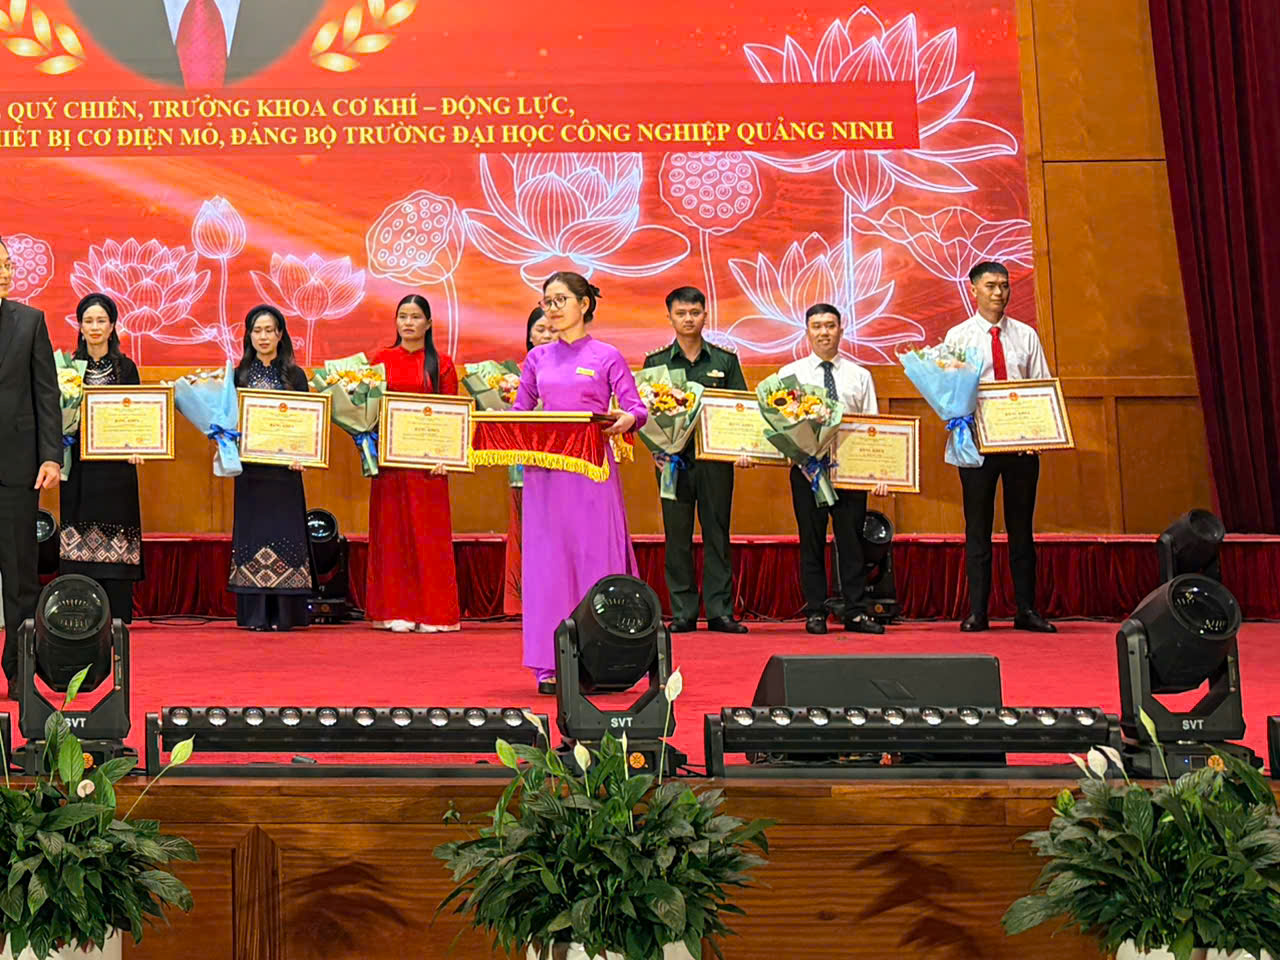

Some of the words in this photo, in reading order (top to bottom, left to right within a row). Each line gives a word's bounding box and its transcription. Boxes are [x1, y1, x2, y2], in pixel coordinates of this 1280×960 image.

[7, 96, 57, 123] QUÝ
[63, 96, 144, 121] CHIẾN,
[148, 94, 250, 118] TRƯỞNG
[257, 99, 327, 117] KHOA
[332, 97, 368, 117] CƠ
[373, 93, 418, 116] KHÍ
[441, 96, 511, 119] ĐỘNG
[517, 93, 575, 118] LỰC,
[47, 129, 71, 152] BỊ
[77, 127, 112, 146] CƠ
[117, 126, 173, 150] ĐIỆN
[179, 122, 225, 149] MỎ,
[231, 121, 297, 145] ĐẢNG
[303, 124, 337, 149] BỘ
[342, 121, 446, 144] TRƯỜNG
[453, 125, 495, 147] ĐẠI
[501, 124, 554, 147] HỌC
[560, 119, 631, 142] CÔNG
[636, 121, 731, 146] NGHIỆP
[736, 117, 825, 144] QUẢNG
[830, 121, 894, 140] NINH
[610, 717, 634, 729] SVT
[1182, 719, 1205, 730] SVT
